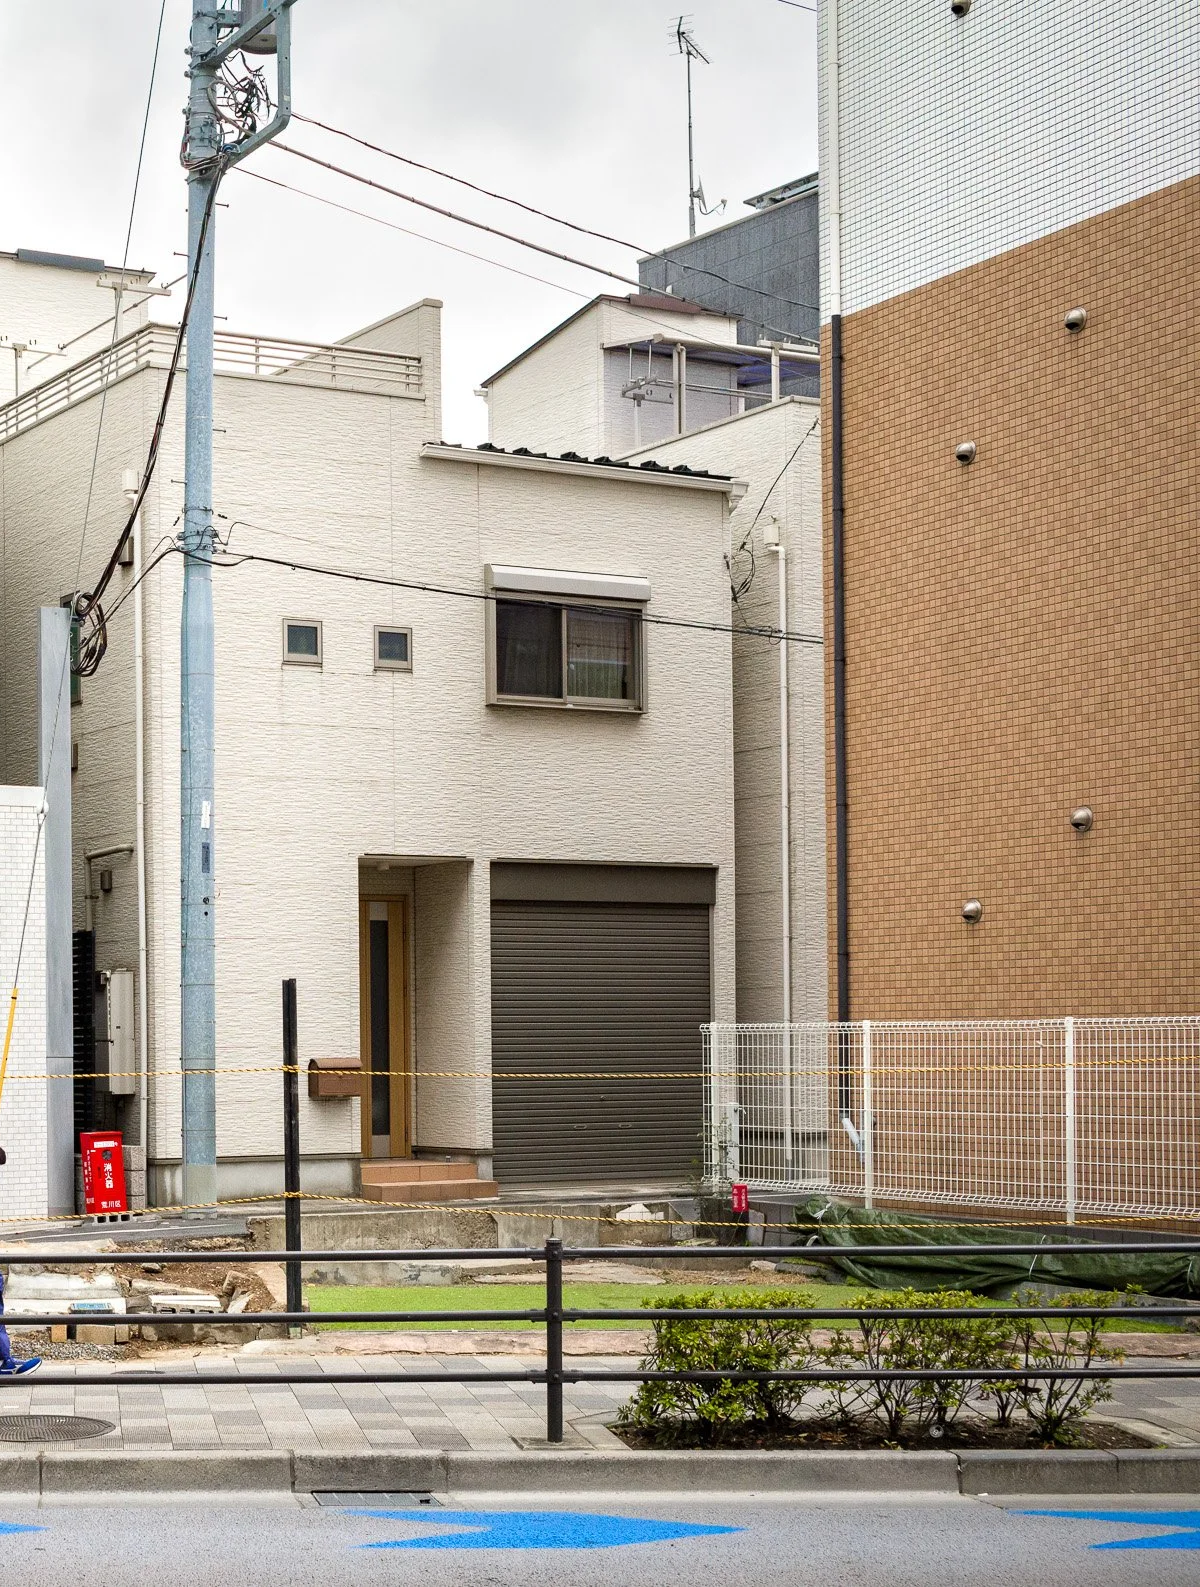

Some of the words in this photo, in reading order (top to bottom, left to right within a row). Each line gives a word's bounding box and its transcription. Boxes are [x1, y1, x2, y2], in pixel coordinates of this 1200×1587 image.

[103, 1163, 114, 1189] 消火器
[100, 1200, 122, 1209] 荒川区
